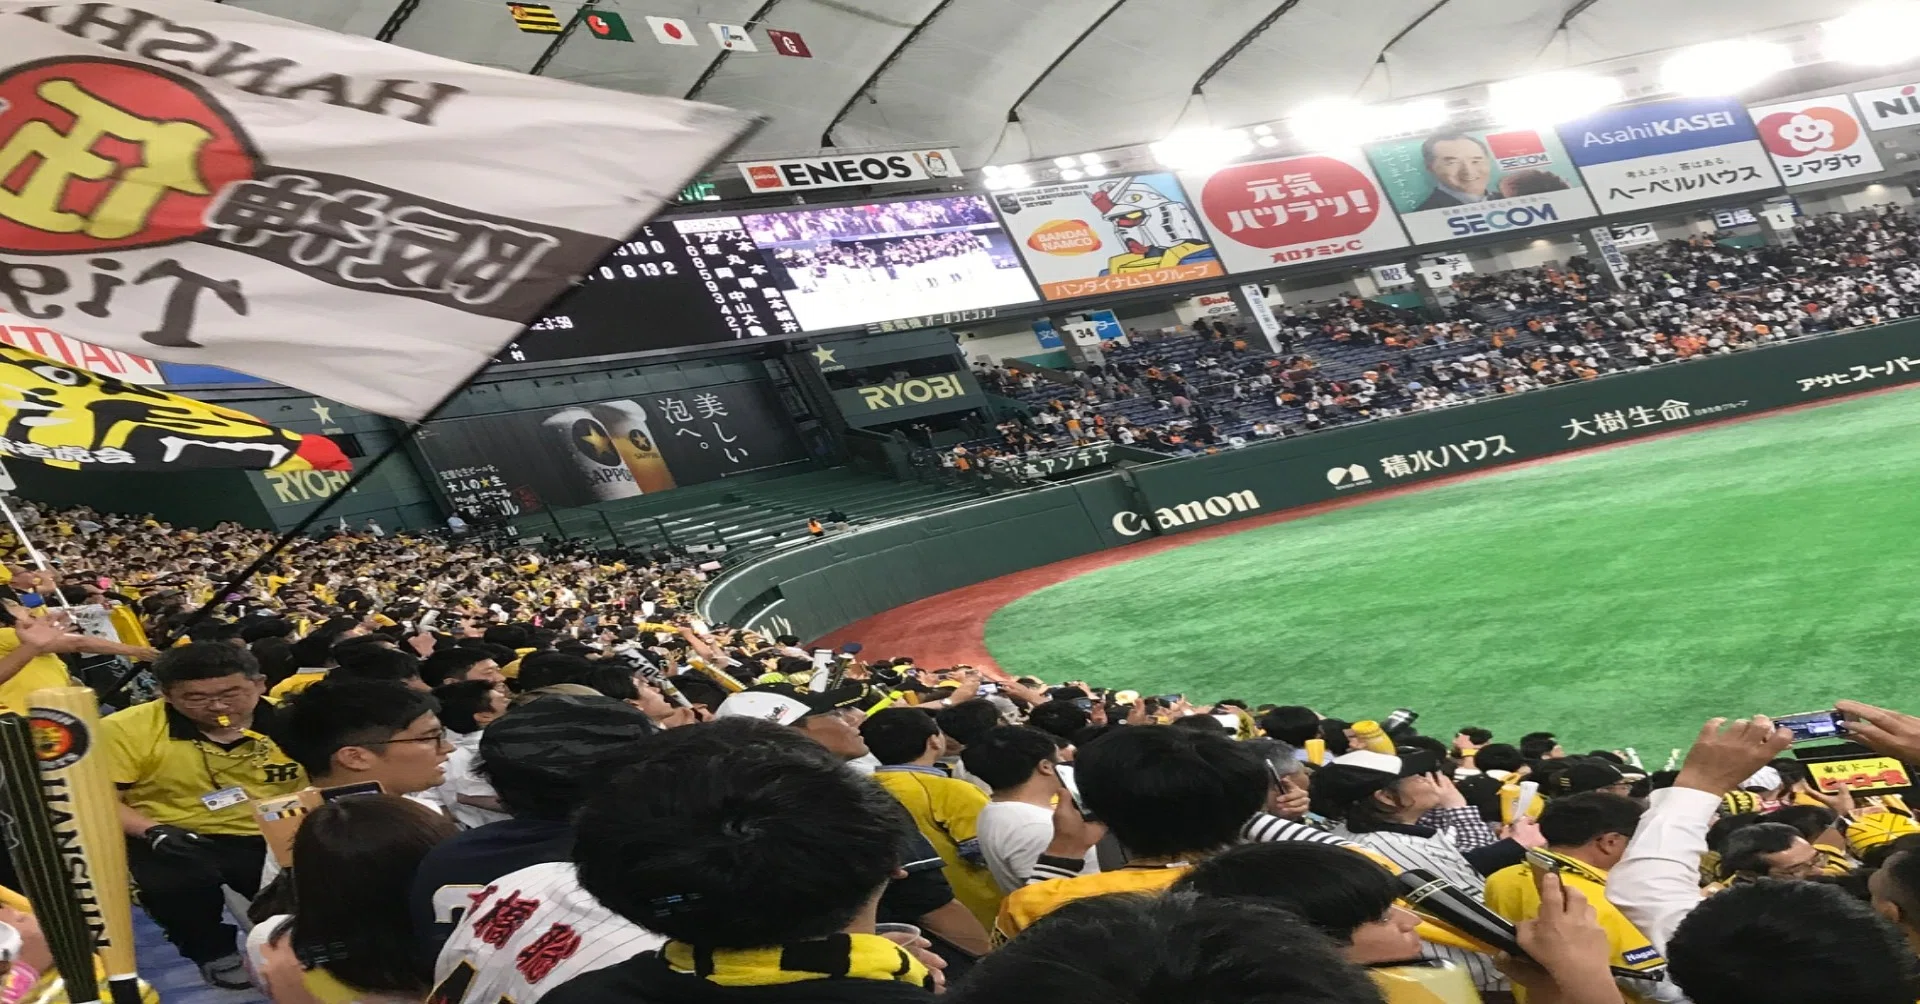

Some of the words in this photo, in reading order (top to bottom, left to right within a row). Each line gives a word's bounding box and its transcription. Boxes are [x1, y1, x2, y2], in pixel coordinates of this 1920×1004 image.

[1583, 111, 1736, 149] AsahiKASEI
[780, 156, 912, 186] ENEOS
[1782, 153, 1862, 178] シマダヤ
[1246, 172, 1324, 204] 元気
[1608, 166, 1763, 200] ヘーベルハウス
[1447, 203, 1559, 236] SECOM
[1038, 229, 1089, 242] BANDAI
[650, 240, 666, 254] 0
[1042, 237, 1093, 251] NAMCO
[599, 266, 616, 280] 0
[621, 264, 638, 278] 8
[638, 262, 661, 277] 13
[661, 261, 679, 275] 2
[692, 257, 706, 269] 8
[699, 269, 713, 281] 5
[1432, 271, 1443, 280] 3
[705, 280, 720, 293] 9
[720, 304, 733, 315] 4
[725, 315, 739, 328] 2
[731, 327, 743, 339] 7
[1076, 328, 1095, 339] 34
[858, 374, 965, 410] RYOBI
[693, 392, 749, 463] 美しい
[1562, 399, 1691, 440] 大樹生命
[1379, 434, 1516, 479] 積水ハウス
